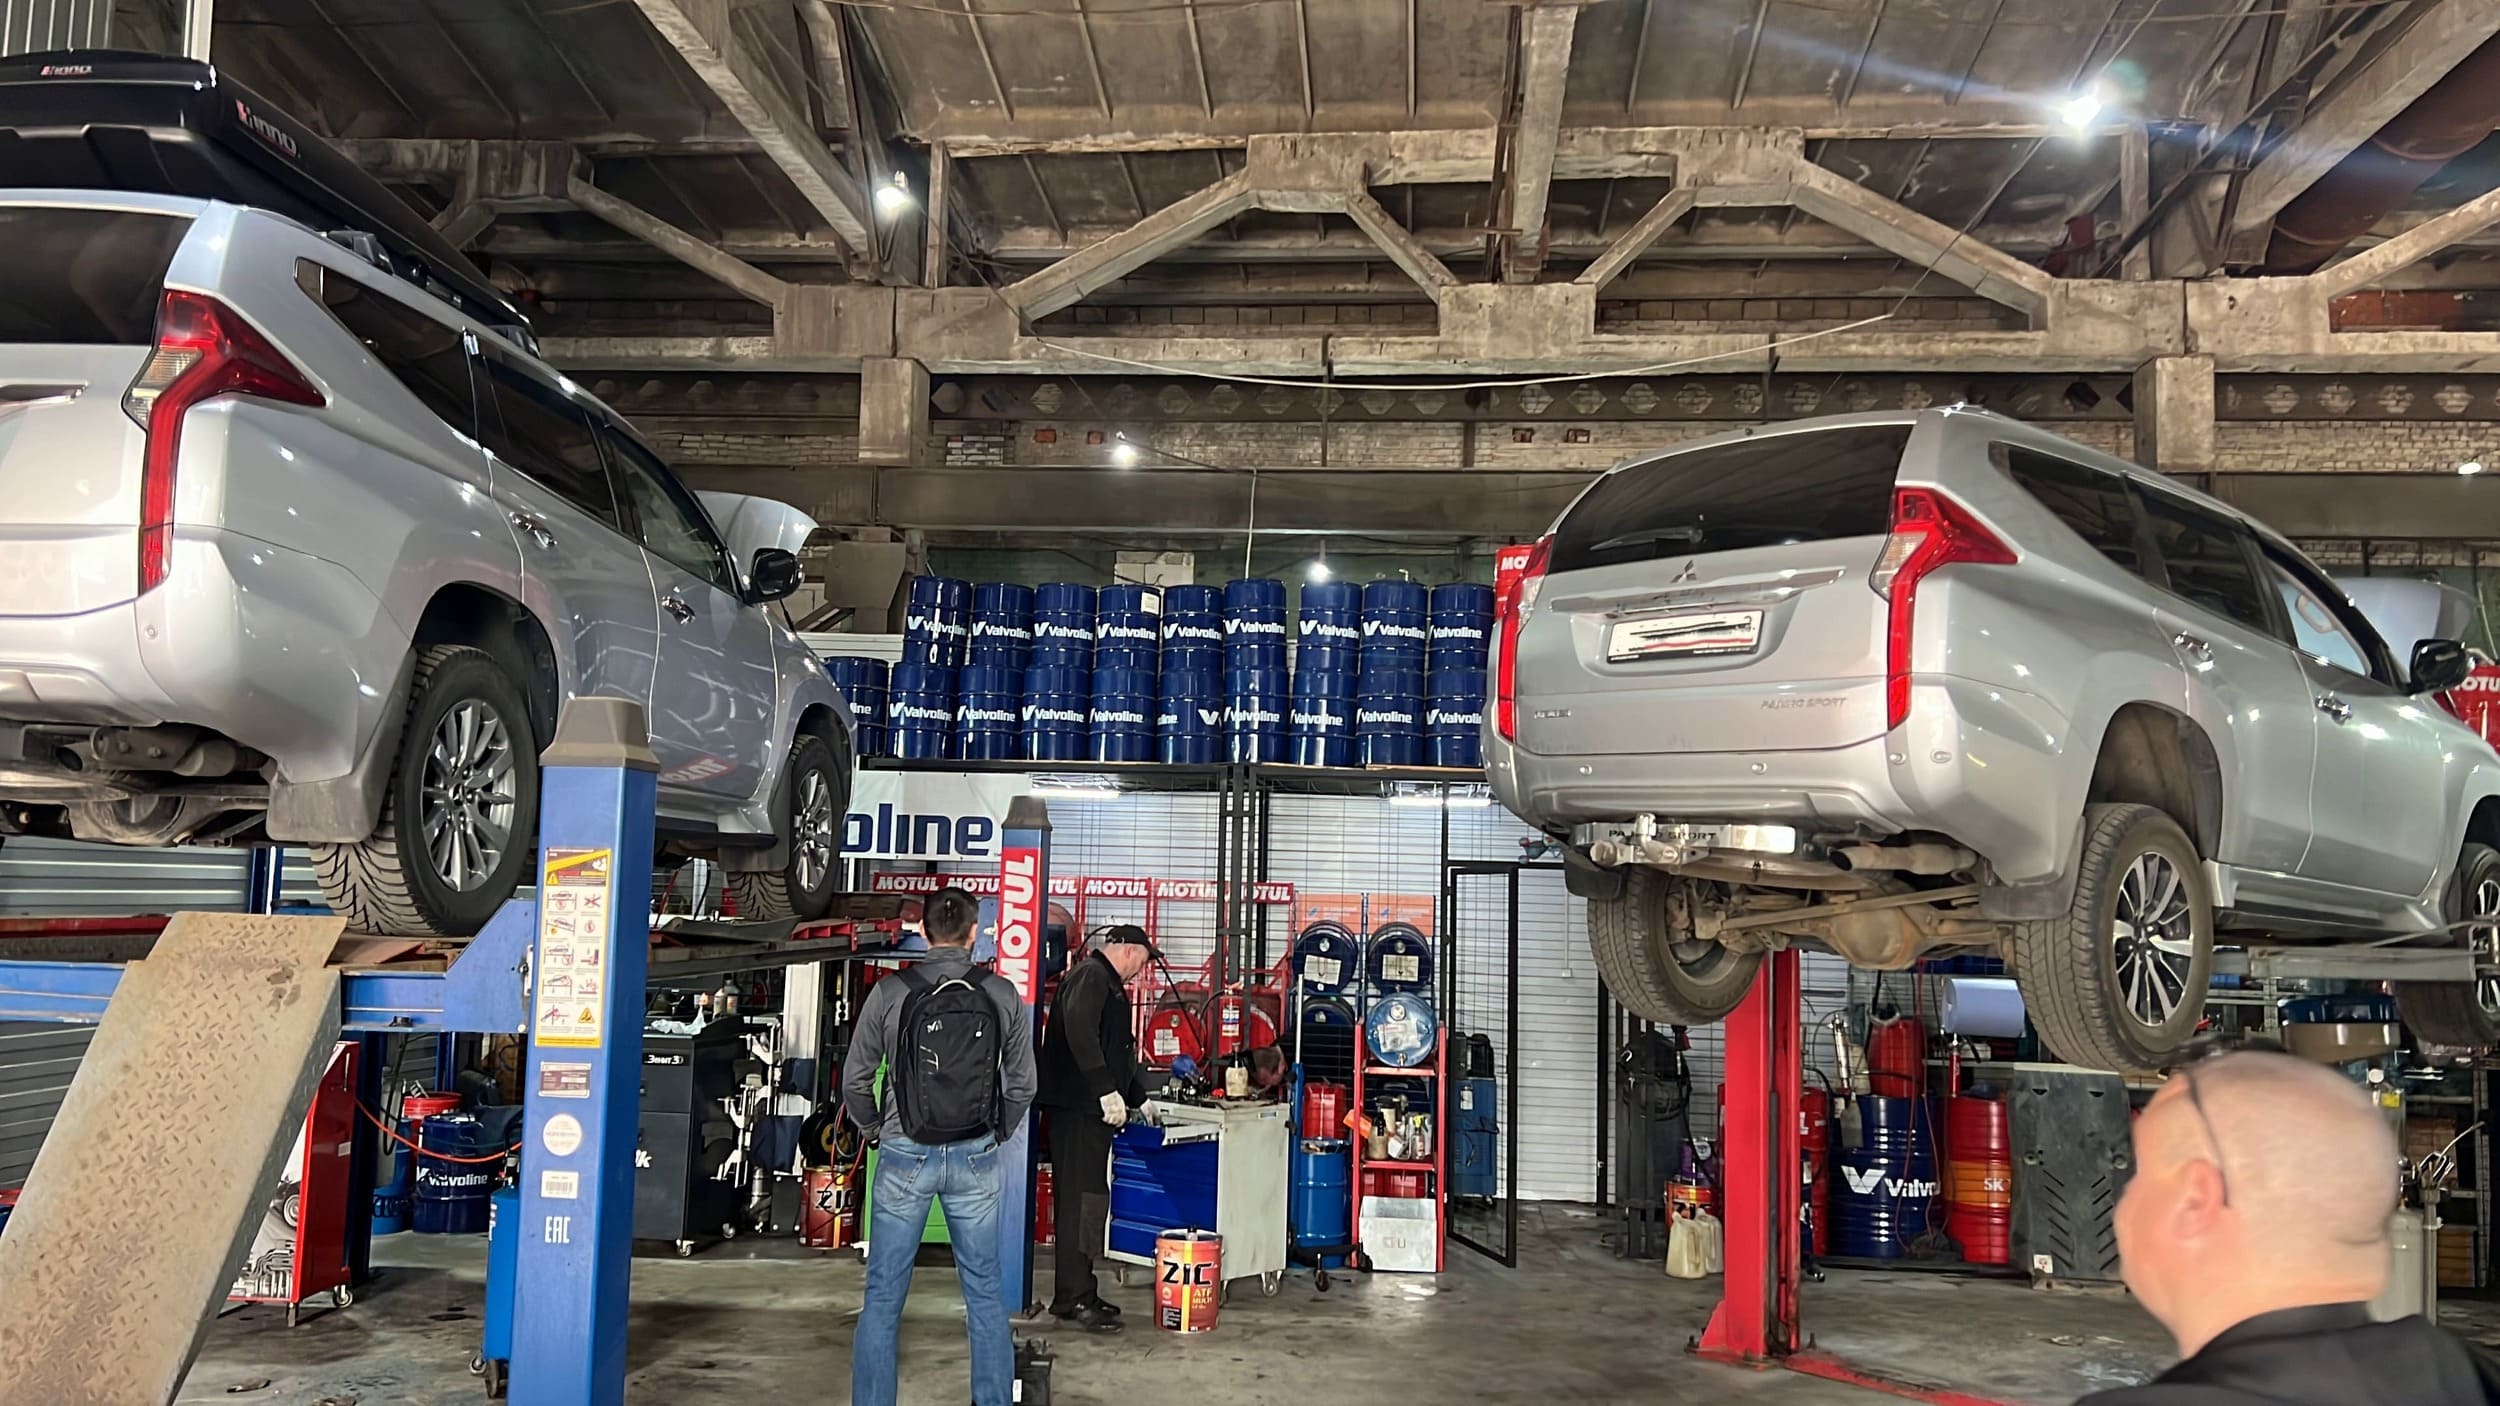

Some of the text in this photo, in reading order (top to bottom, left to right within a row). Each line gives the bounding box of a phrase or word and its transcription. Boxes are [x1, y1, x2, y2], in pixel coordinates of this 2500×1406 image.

[923, 620, 967, 636] Valvolin
[1109, 626, 1156, 641] Valvoline
[1433, 626, 1483, 639] Valvoline
[965, 708, 1016, 722] Valvoline
[1035, 708, 1085, 723] Valvoline
[1094, 710, 1144, 723] Valvoline
[1230, 709, 1280, 723] Valvoline
[1361, 710, 1413, 724] Valvoline
[876, 876, 940, 892] MOTUL
[1085, 880, 1149, 897] MOTUL
[1000, 855, 1035, 997] MOTUL
[544, 1215, 571, 1244] EAC
[1161, 1260, 1214, 1286] ZIC
